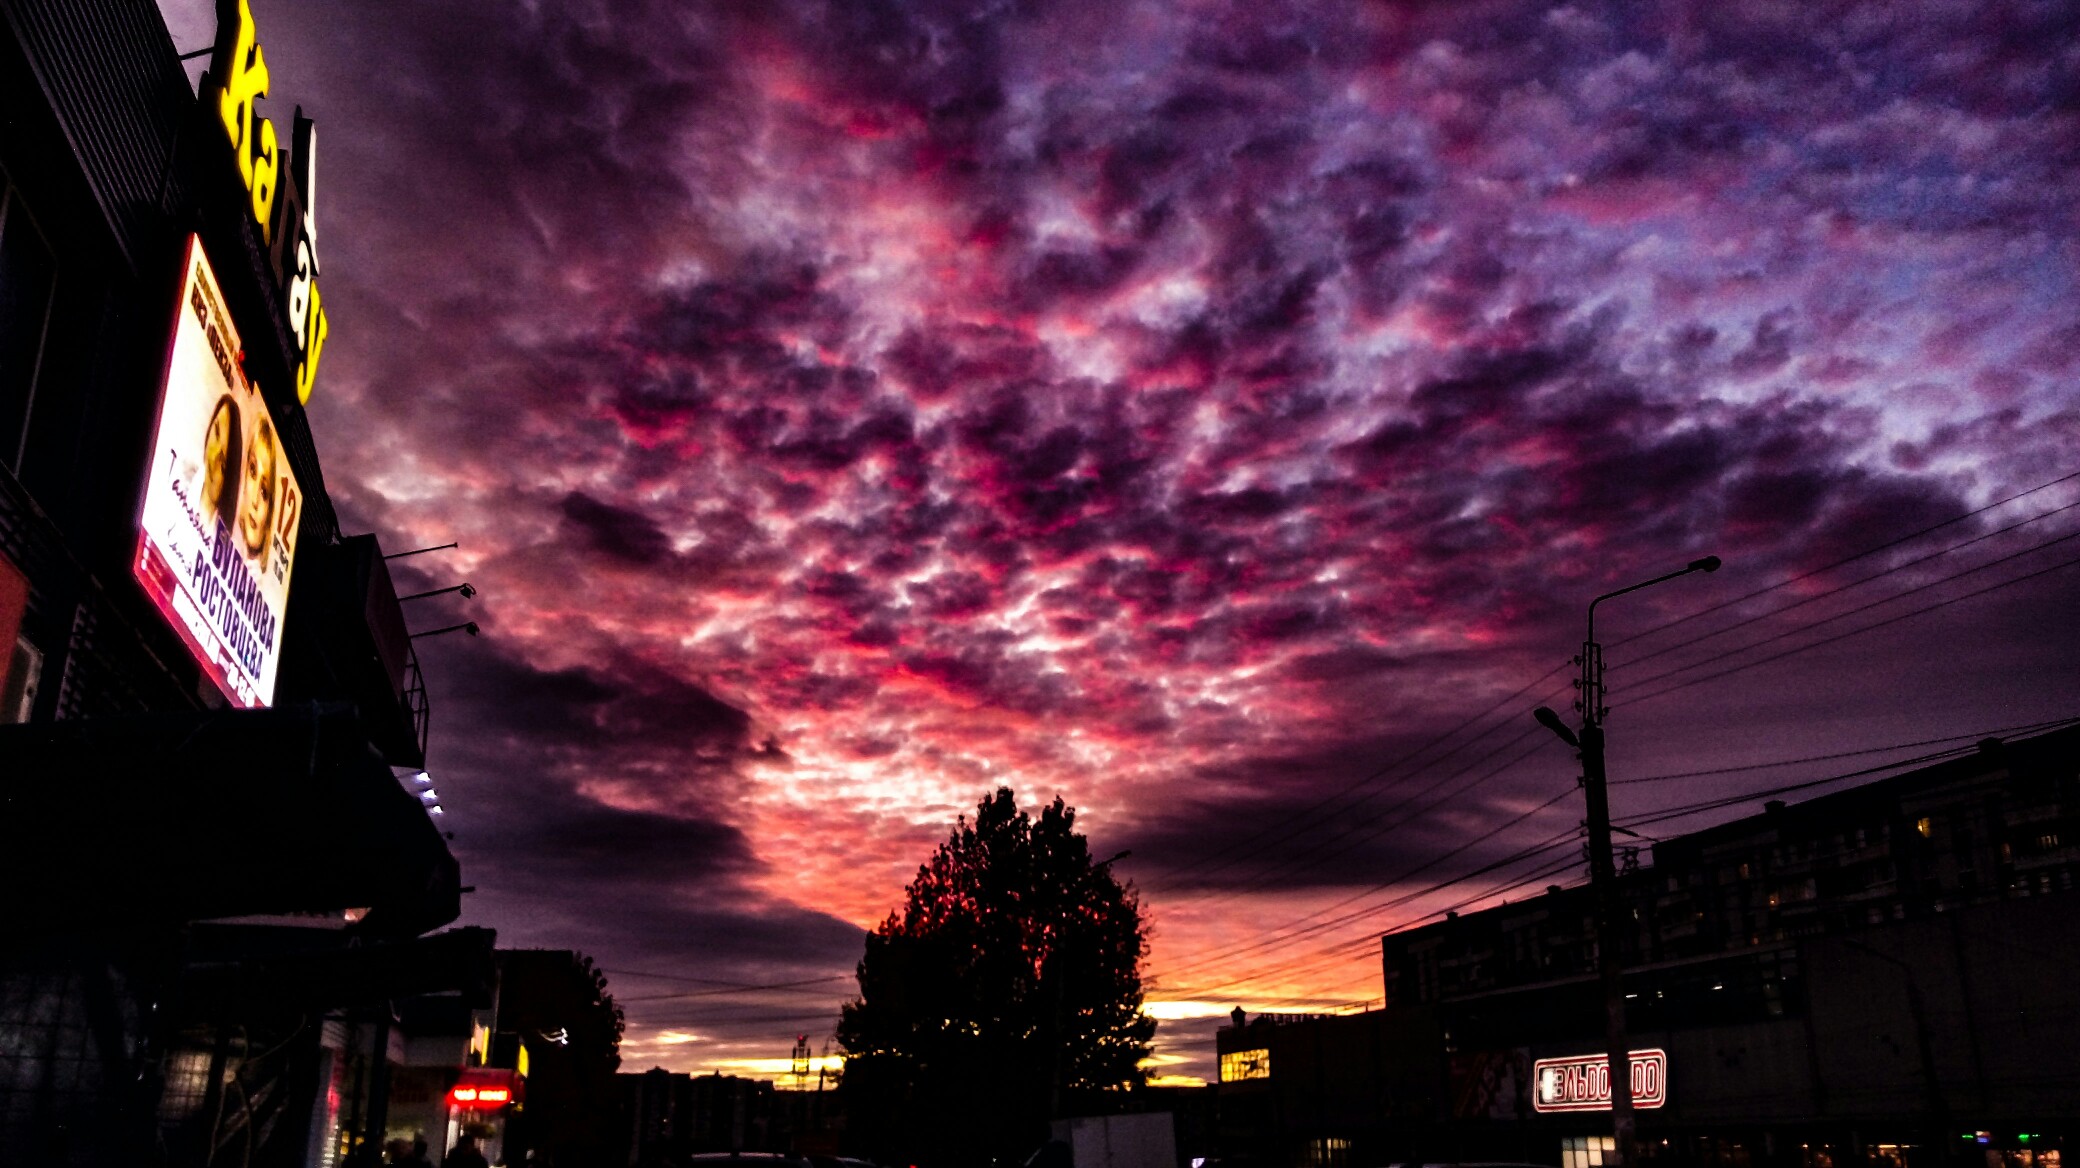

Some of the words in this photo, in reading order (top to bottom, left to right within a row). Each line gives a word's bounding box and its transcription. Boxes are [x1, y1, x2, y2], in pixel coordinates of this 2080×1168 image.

[277, 476, 297, 551] 12
[192, 549, 264, 684] РОСТОВЦЕВА
[212, 514, 276, 656] БУЛАНОВА
